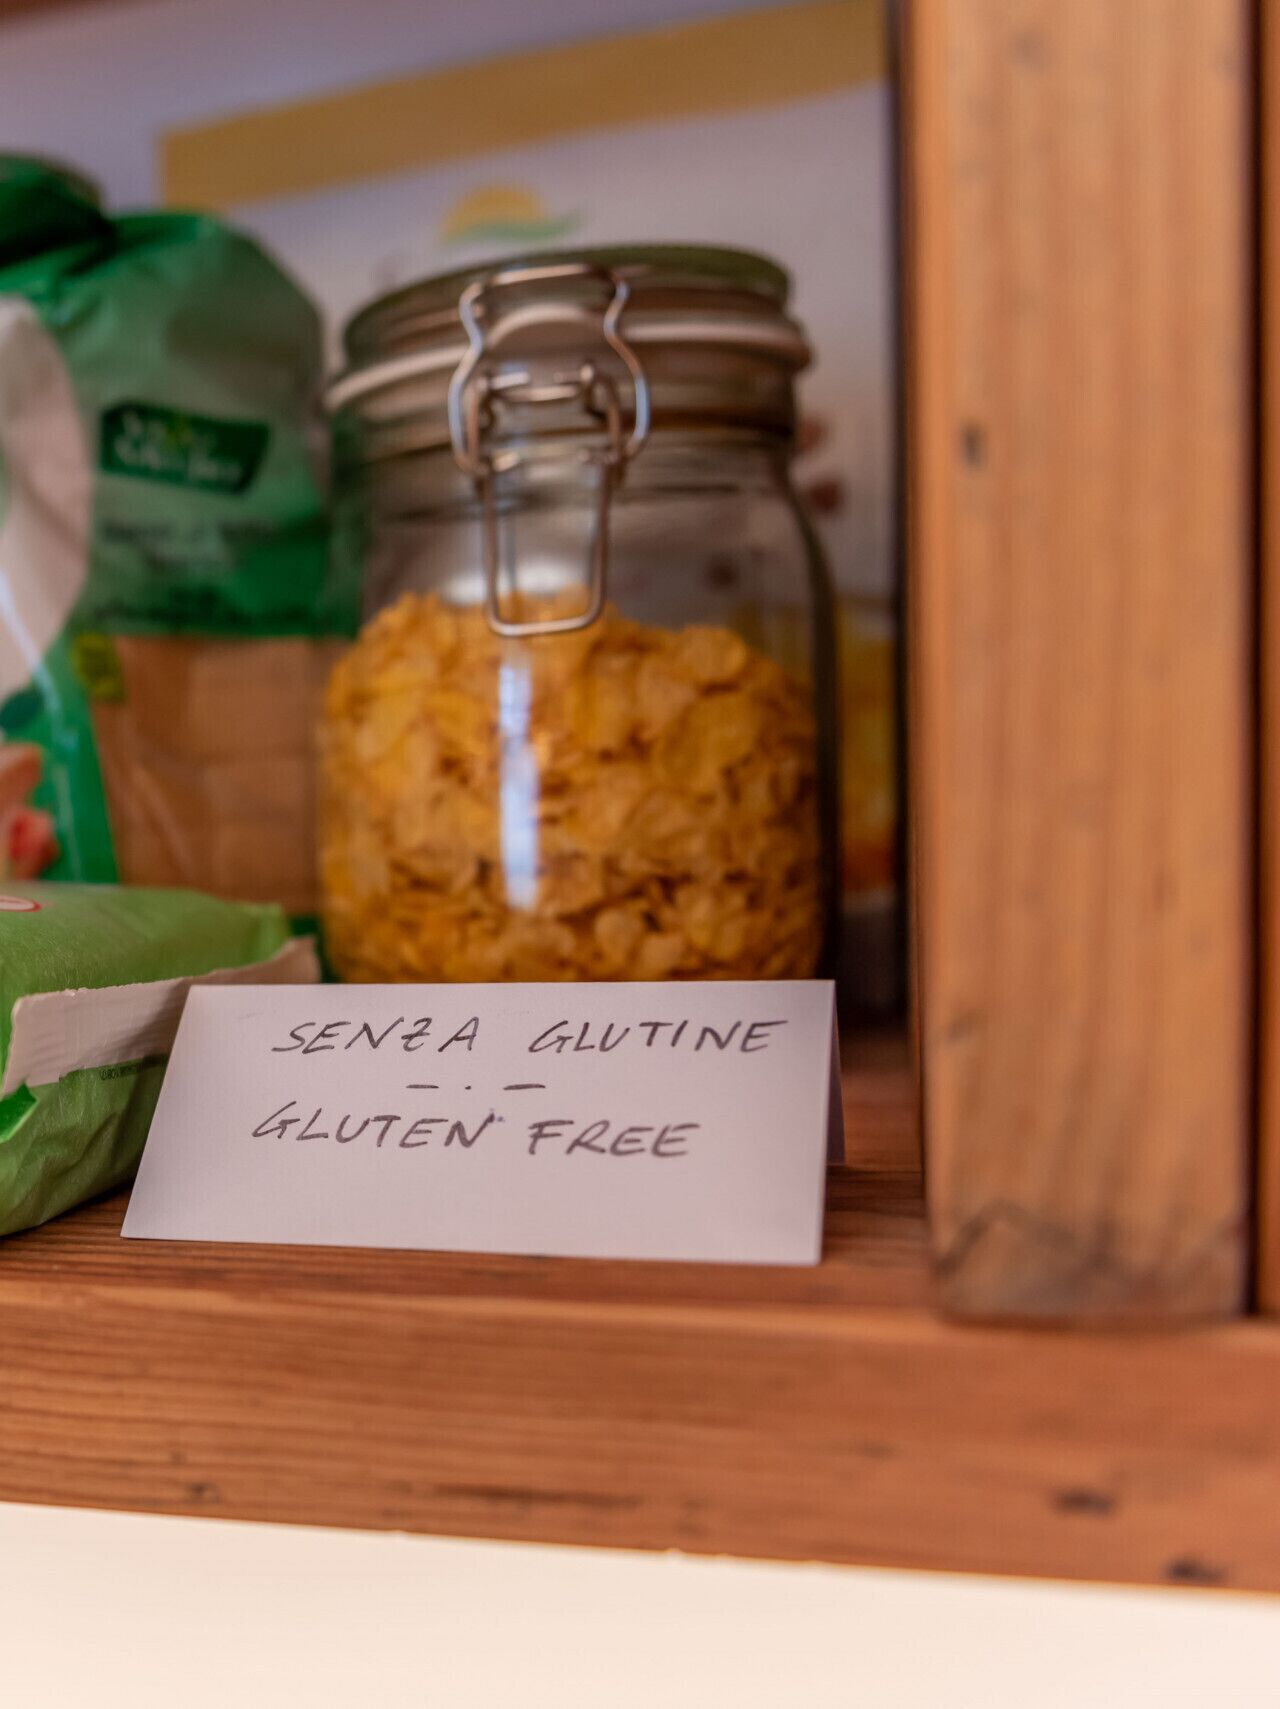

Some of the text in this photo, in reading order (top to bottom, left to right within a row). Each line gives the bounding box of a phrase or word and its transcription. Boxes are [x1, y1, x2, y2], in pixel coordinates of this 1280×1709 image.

[271, 1016, 789, 1056] SENZA GLUTINE
[251, 1100, 702, 1159] GLUTEN FREE
